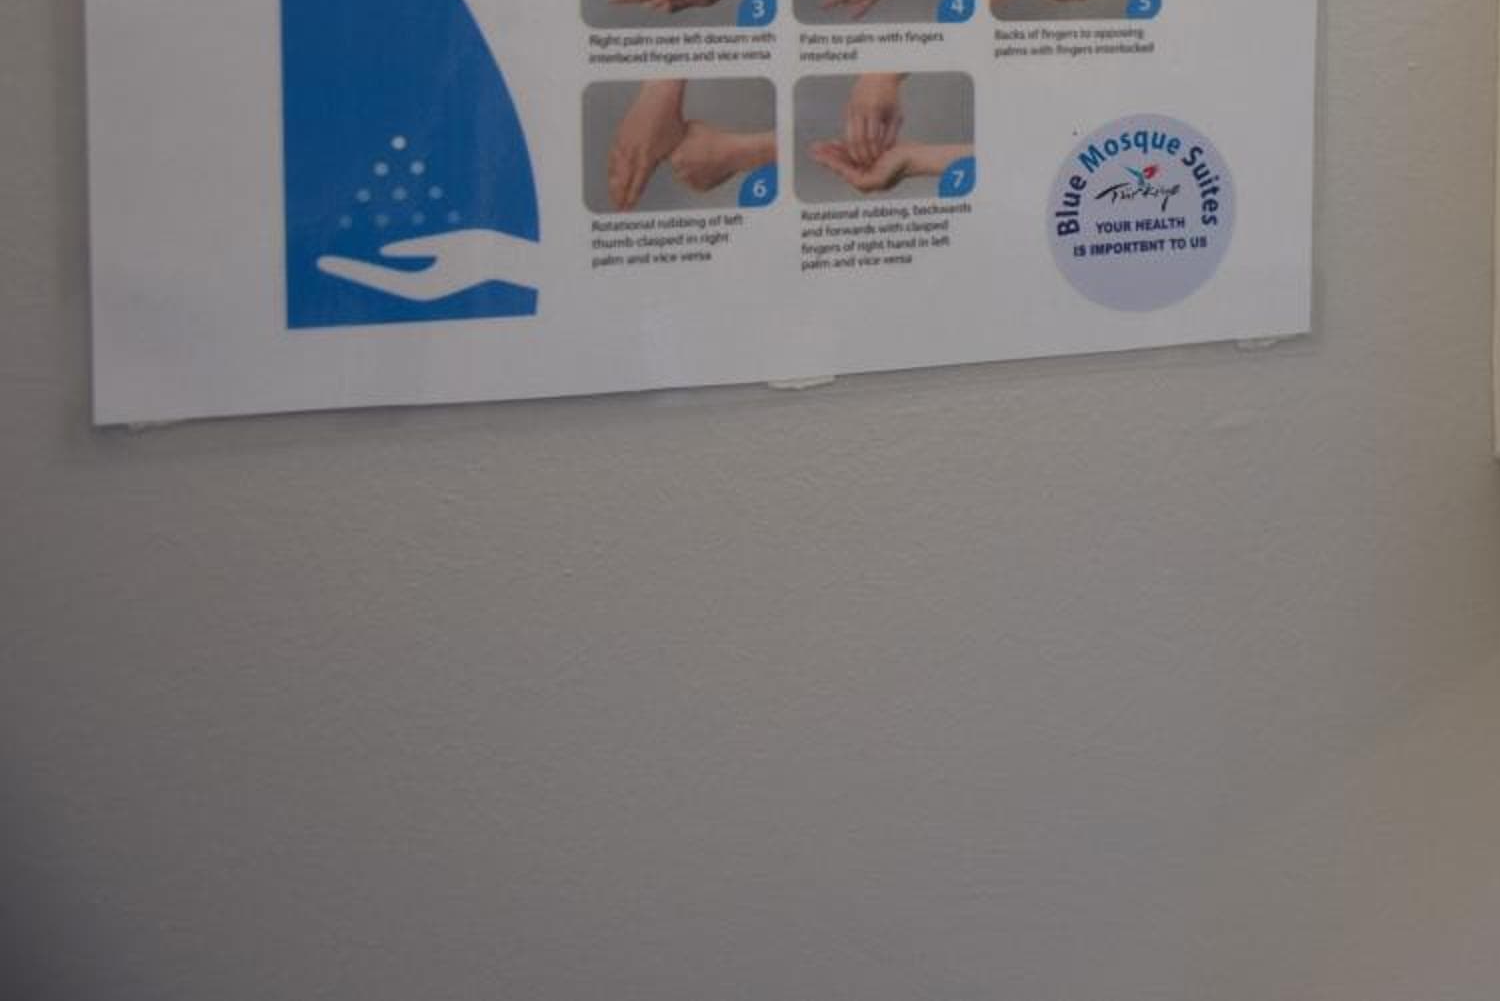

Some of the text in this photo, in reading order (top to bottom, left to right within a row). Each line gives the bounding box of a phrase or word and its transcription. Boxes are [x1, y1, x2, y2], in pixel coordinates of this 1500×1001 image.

[751, 0, 766, 19] 3
[589, 34, 620, 49] Right
[623, 35, 653, 47] palm
[656, 36, 681, 45] over
[683, 32, 702, 44] left
[751, 32, 776, 43] with
[831, 33, 843, 44] to
[845, 33, 875, 46] palm
[878, 31, 903, 43] with
[905, 30, 945, 45] fingers
[693, 50, 715, 61] and
[718, 50, 738, 61] vice
[742, 51, 771, 61] versa
[951, 170, 965, 188] 7
[1055, 130, 1221, 236] Blue Mosque Suites
[752, 179, 768, 198] 6
[801, 207, 859, 221] Rotational
[912, 202, 972, 216] backwards
[591, 213, 744, 232] Rotational rubbing of left
[801, 219, 949, 238] and forwards with clasped
[1096, 217, 1186, 234] YOUR HEALTH
[591, 232, 729, 249] thumb clasped in right
[801, 235, 950, 256] fingers of right hand in left
[1073, 244, 1086, 257] IS
[1169, 237, 1187, 250] TO
[1189, 236, 1208, 249] US
[591, 251, 712, 269] palm and vice versa
[801, 254, 912, 272] palm and vice versa
